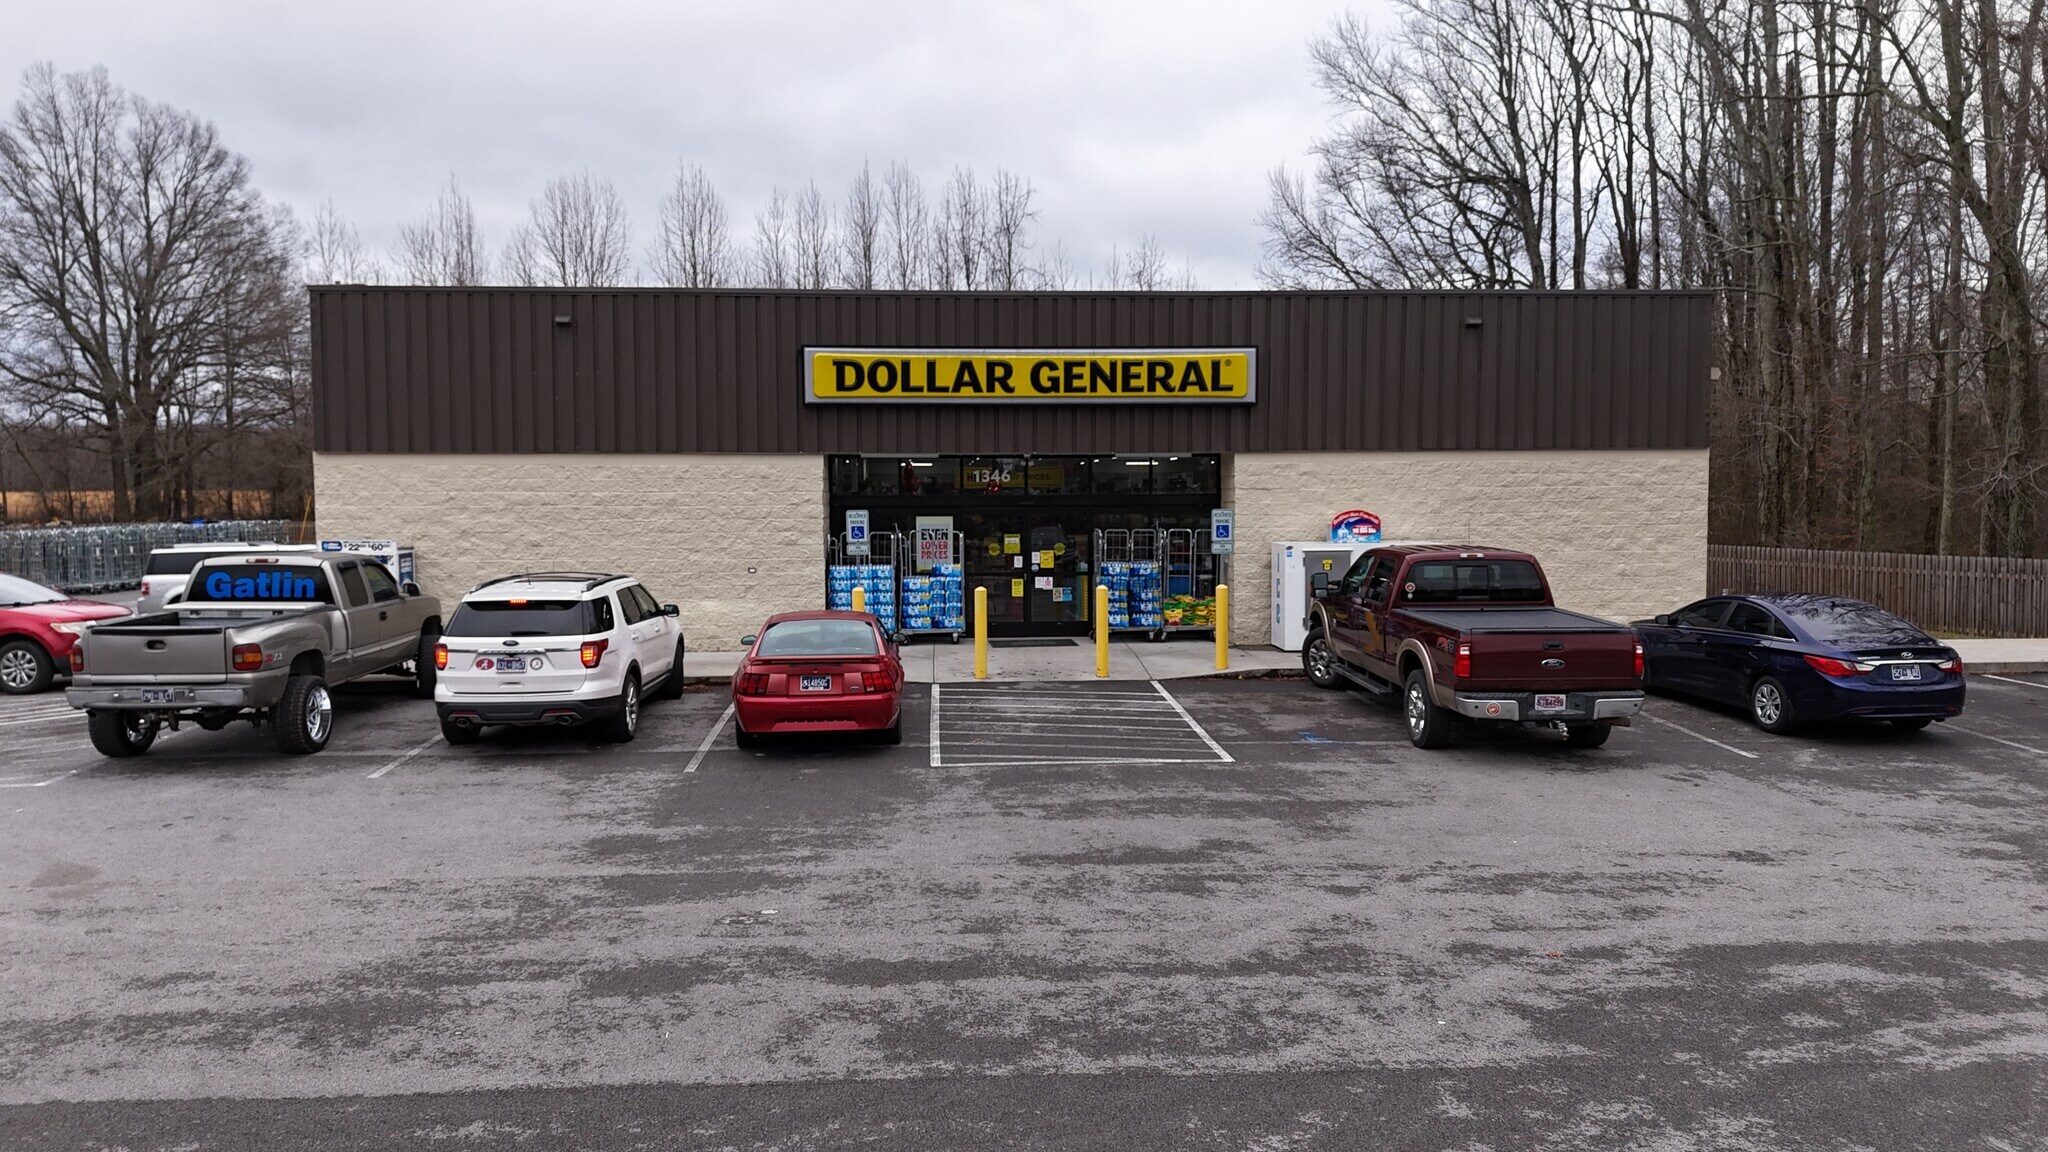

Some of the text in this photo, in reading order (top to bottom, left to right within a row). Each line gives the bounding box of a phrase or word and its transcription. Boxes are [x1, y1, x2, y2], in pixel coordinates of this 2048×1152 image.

[832, 359, 1016, 394] DOLLAR
[972, 469, 1011, 483] 1346
[205, 571, 316, 599] Gatlin
